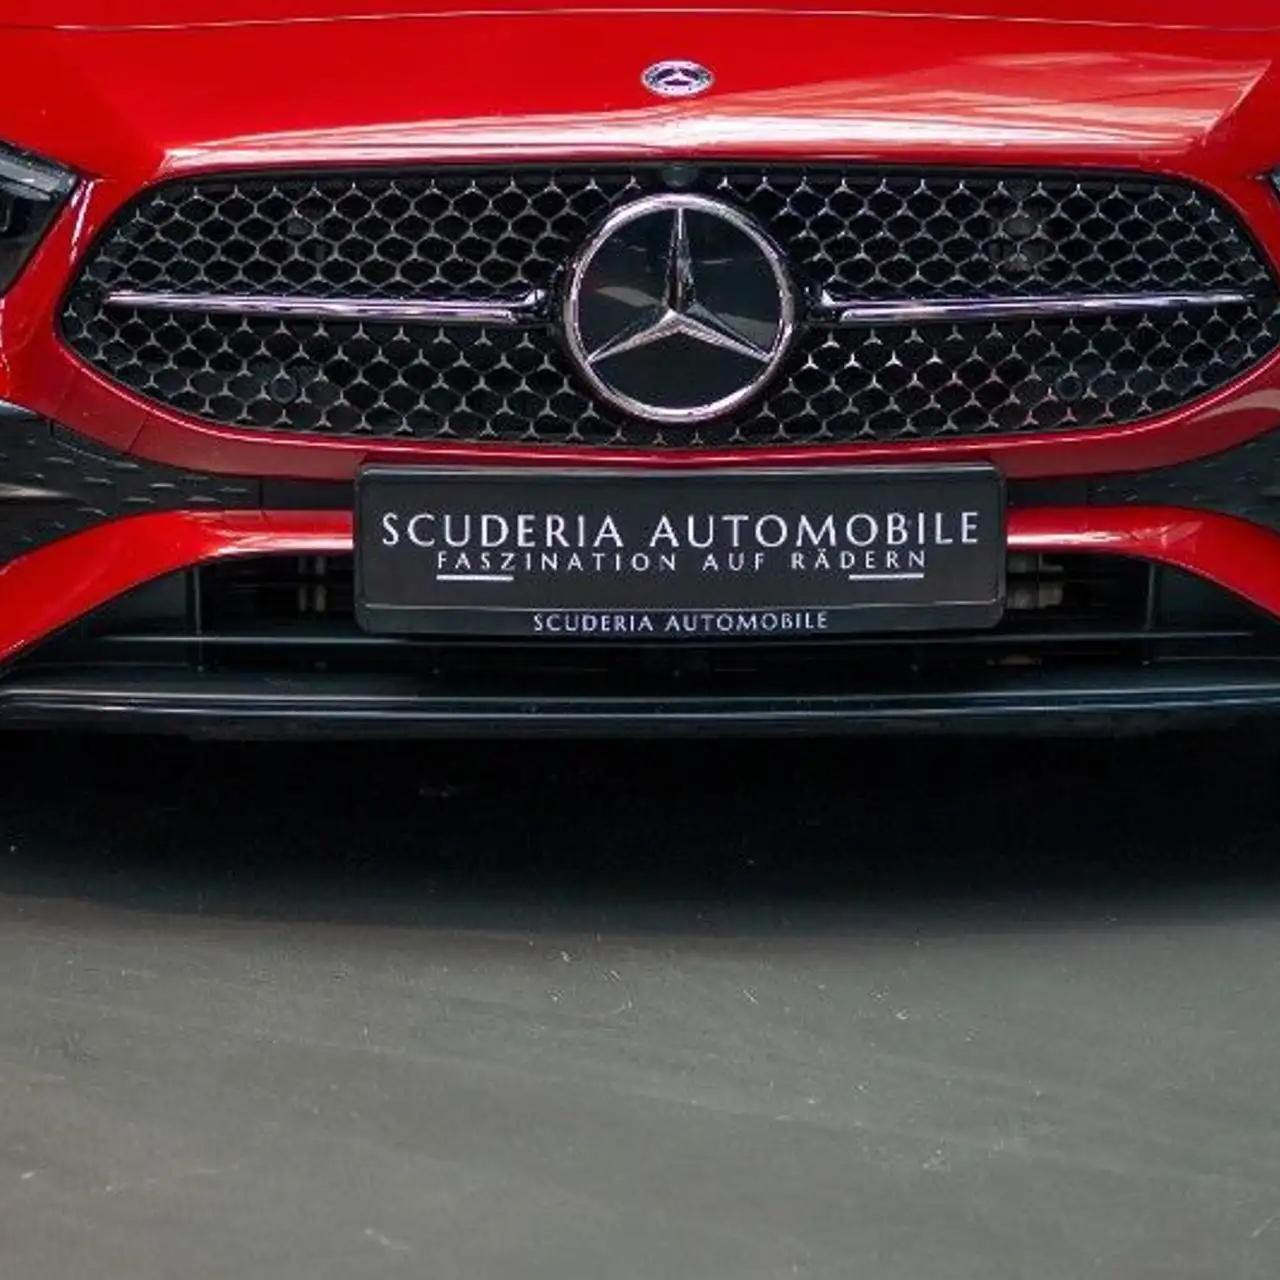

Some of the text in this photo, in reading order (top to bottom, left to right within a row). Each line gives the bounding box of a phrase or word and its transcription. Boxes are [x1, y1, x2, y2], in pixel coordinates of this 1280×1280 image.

[381, 511, 978, 548] SCUDERIA AUTOMOBILE
[437, 547, 926, 571] FASZINATION AUF RÄDERN
[533, 610, 828, 632] SCUDERIA AUTOMOBILE
